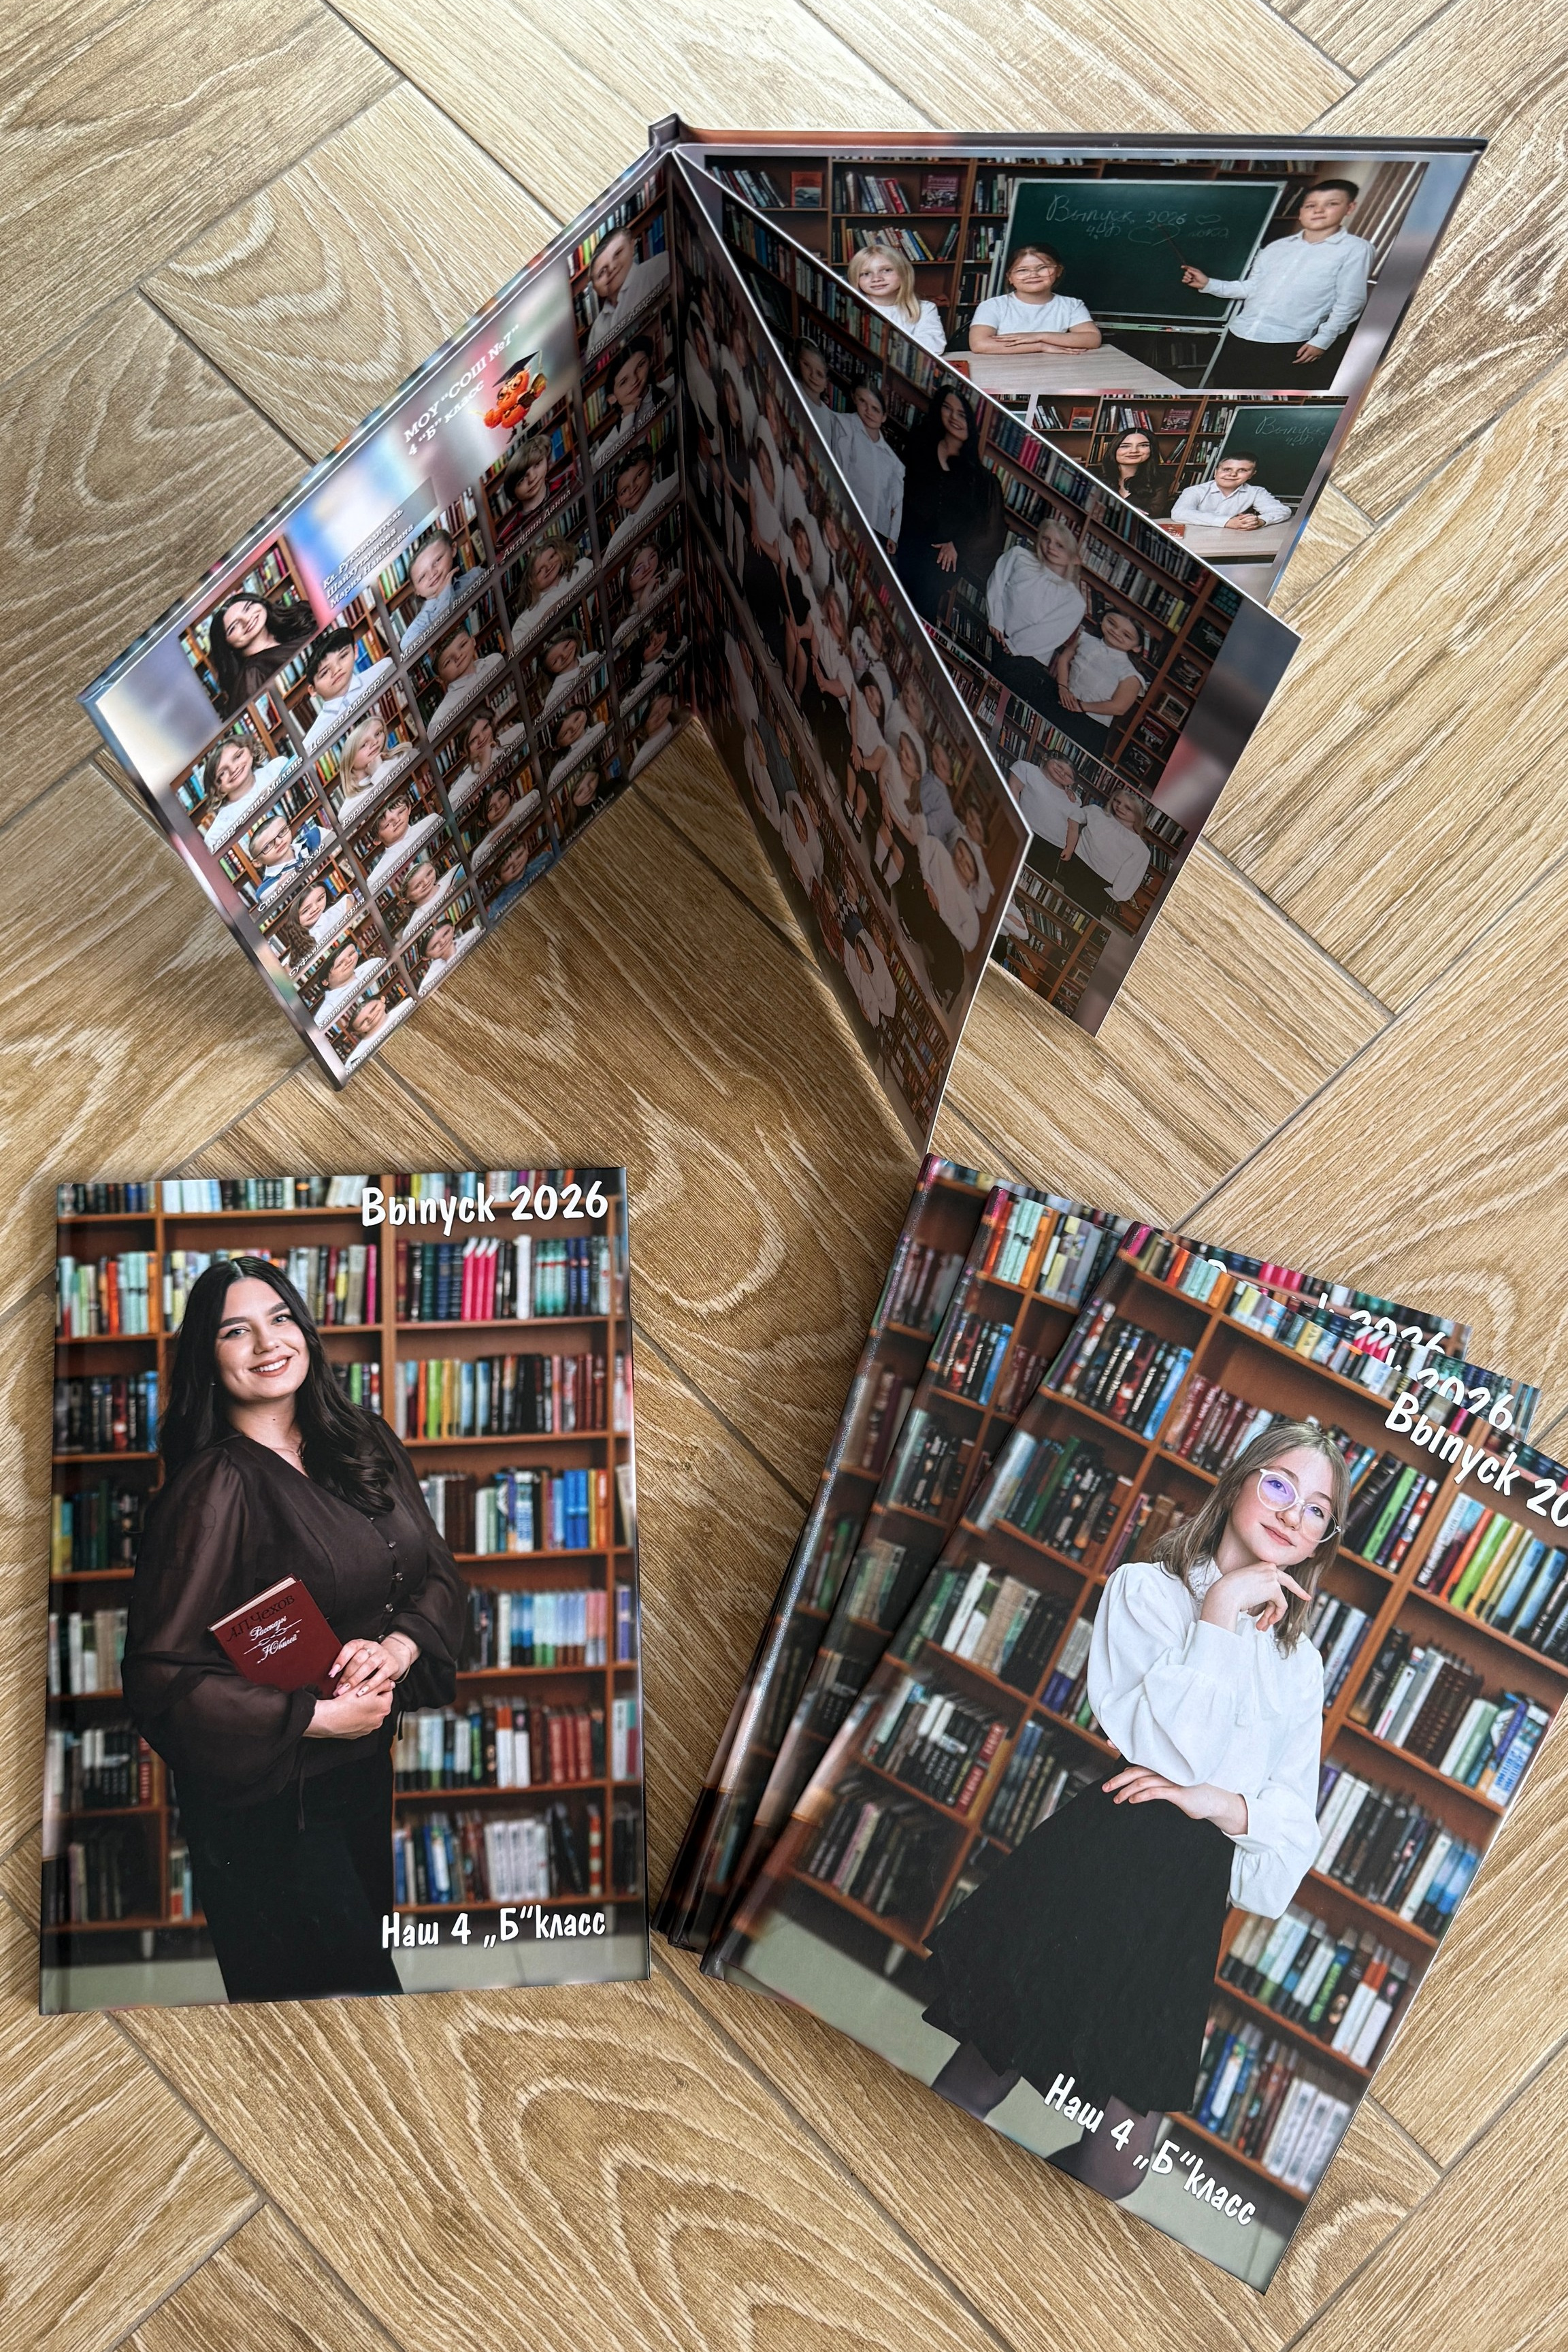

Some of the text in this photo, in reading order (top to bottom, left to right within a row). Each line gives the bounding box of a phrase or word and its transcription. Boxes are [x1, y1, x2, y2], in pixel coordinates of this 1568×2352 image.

[1146, 211, 1187, 225] 2026
[404, 401, 440, 443] МОУ
[408, 442, 418, 458] 4
[443, 378, 484, 424] класс
[637, 393, 666, 431] Мария
[324, 525, 396, 601] Шайхутдинова
[338, 506, 404, 576] Руководитель
[329, 572, 363, 609] Мария
[399, 561, 495, 664] Макарьева Виктория
[508, 561, 601, 662] Дмитриева Мирослава
[344, 672, 387, 718] Альберт
[465, 665, 497, 703] Михаил
[574, 648, 606, 686] Варвара
[499, 732, 525, 763] Дарья
[208, 755, 304, 853] Гаврильчик Милана
[342, 755, 410, 828] Борисова Агата
[257, 840, 326, 913] Симаков Захар
[373, 815, 444, 892] Захаров Вячеслав
[361, 1180, 608, 1237] Выпуск 2026
[1385, 1391, 1520, 1496] Выпуск
[250, 1616, 287, 1642] Рассказы
[382, 1912, 440, 1948] Наш
[451, 1912, 472, 1945] 4
[1044, 2073, 1105, 2133] Наш
[1110, 2119, 1135, 2151] 4
